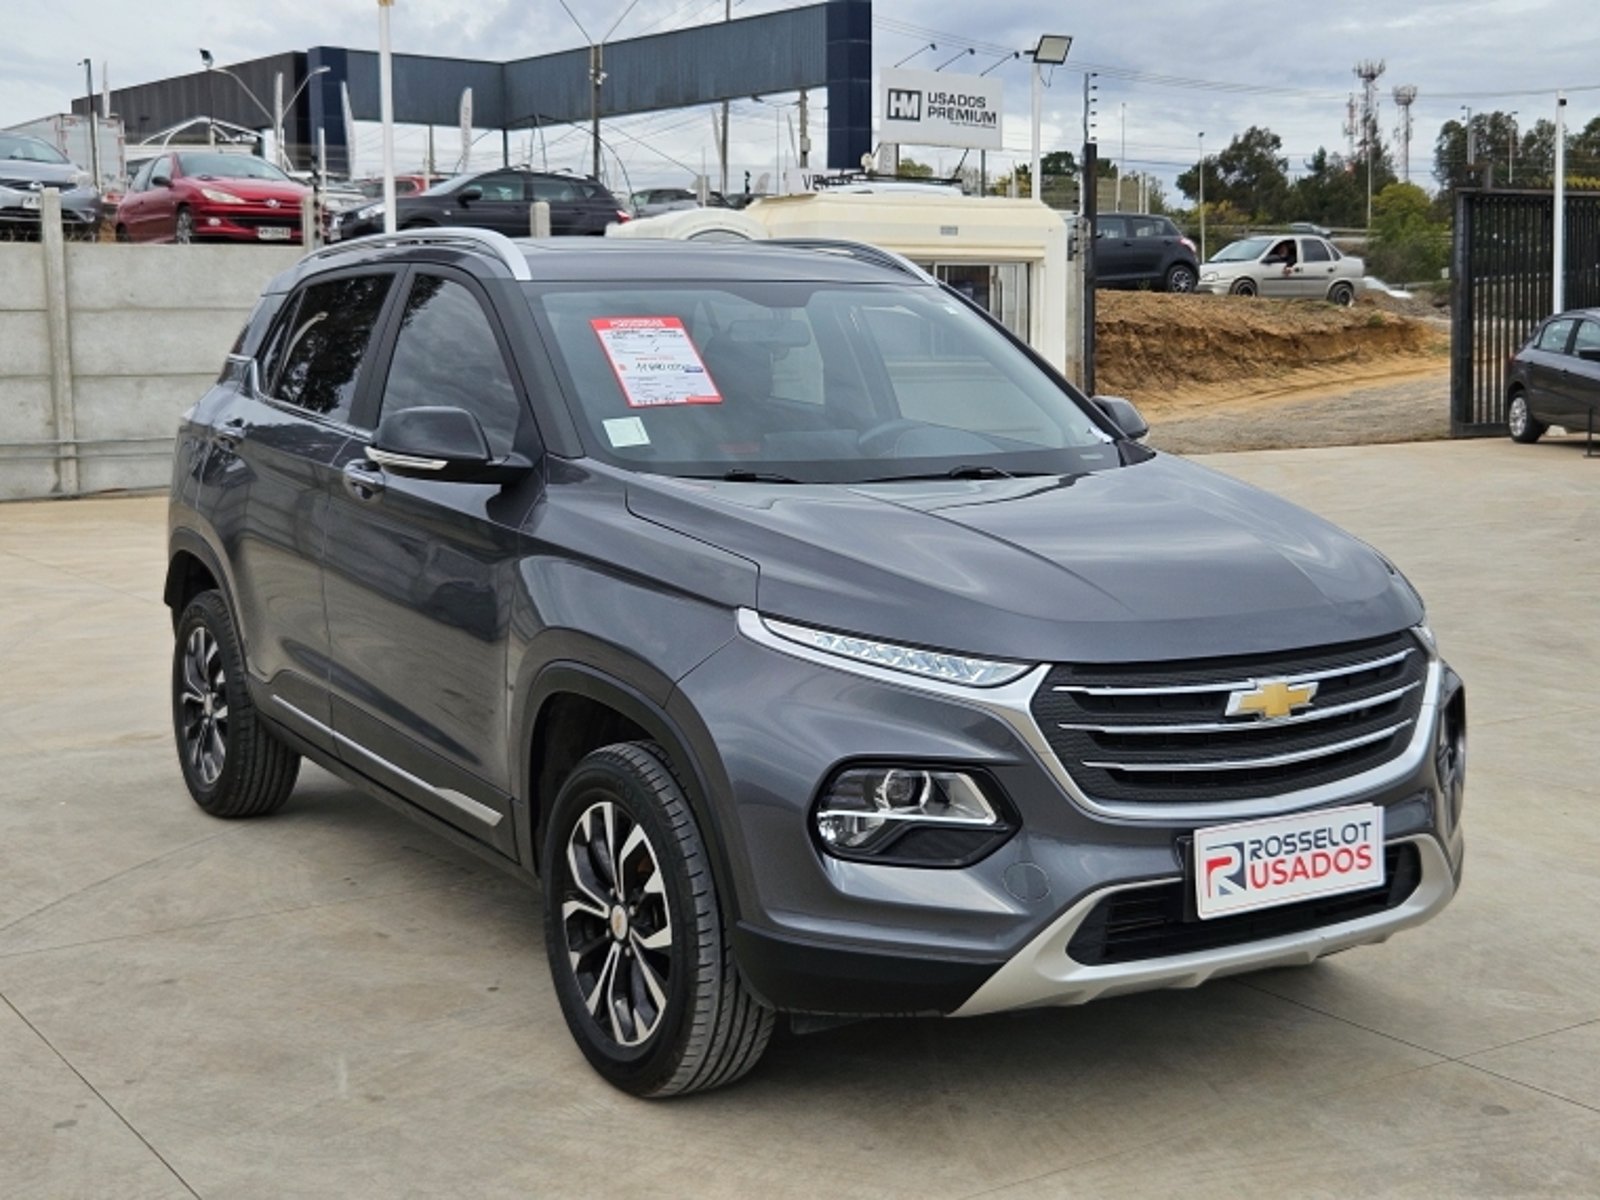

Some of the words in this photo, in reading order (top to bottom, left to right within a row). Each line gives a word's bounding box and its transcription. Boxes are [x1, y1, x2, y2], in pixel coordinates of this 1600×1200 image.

[927, 92, 986, 109] USADOS
[927, 105, 997, 125] PREMIUM
[1250, 821, 1372, 861] ROSSELOT
[1250, 845, 1372, 889] USADOS
